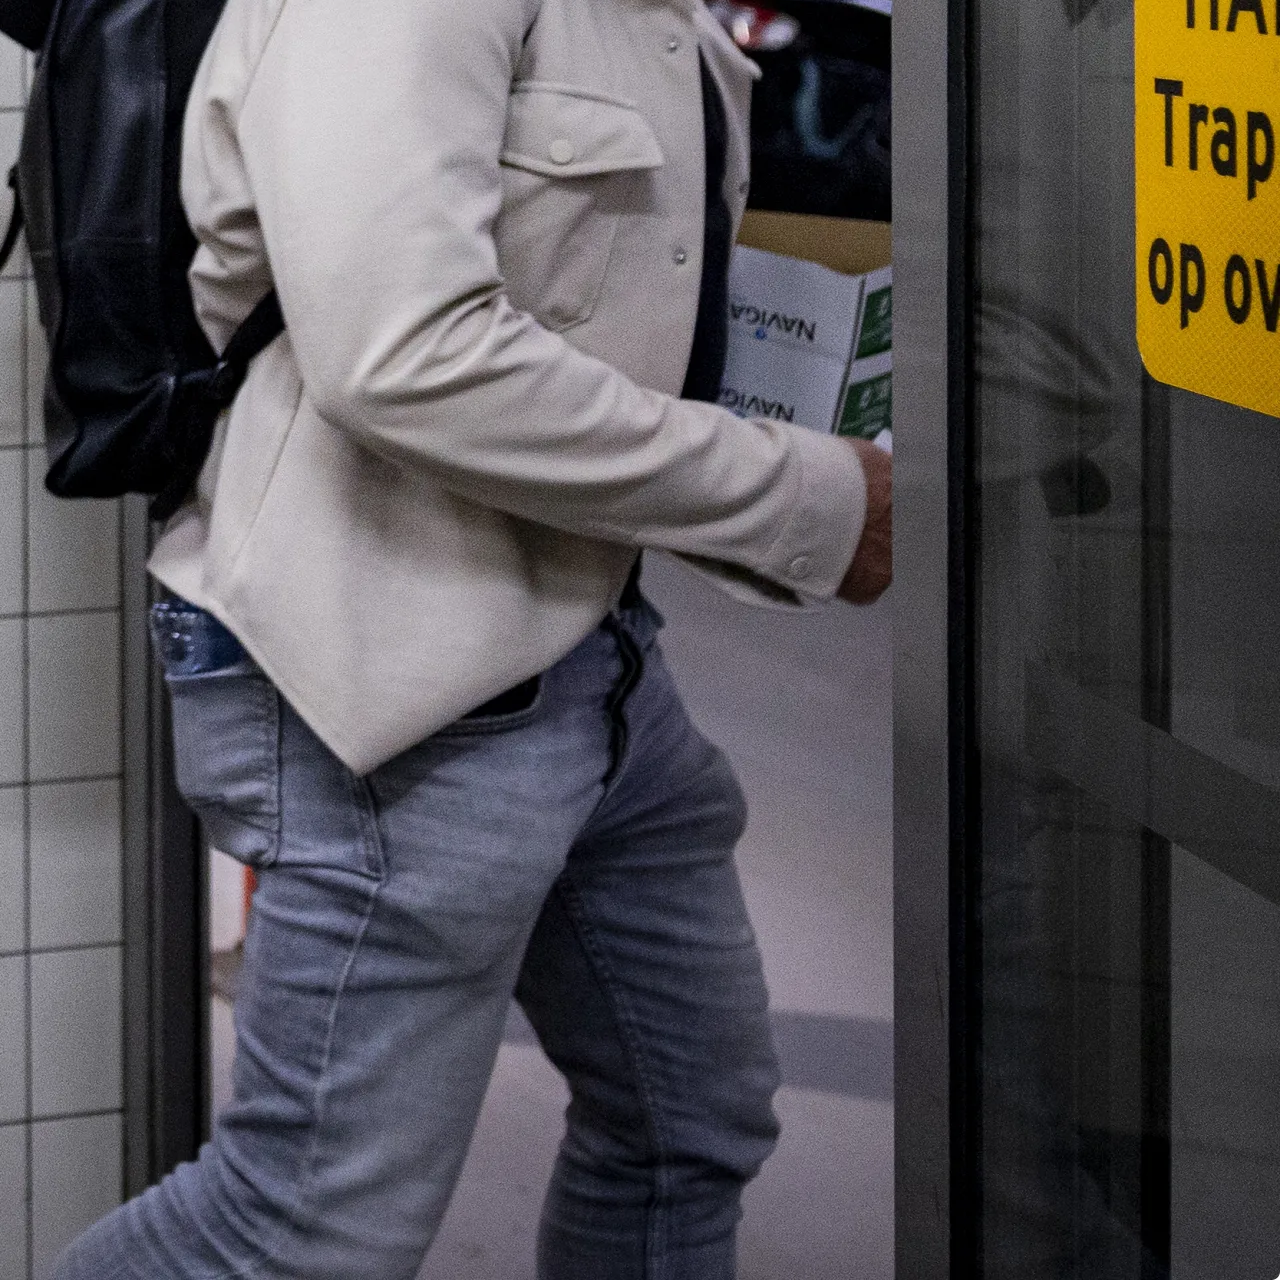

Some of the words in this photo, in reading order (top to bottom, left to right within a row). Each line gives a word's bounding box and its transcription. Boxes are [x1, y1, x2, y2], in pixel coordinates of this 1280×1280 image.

[1154, 77, 1275, 201] Trap
[1148, 237, 1206, 330] op
[719, 387, 795, 423] NAVIG
